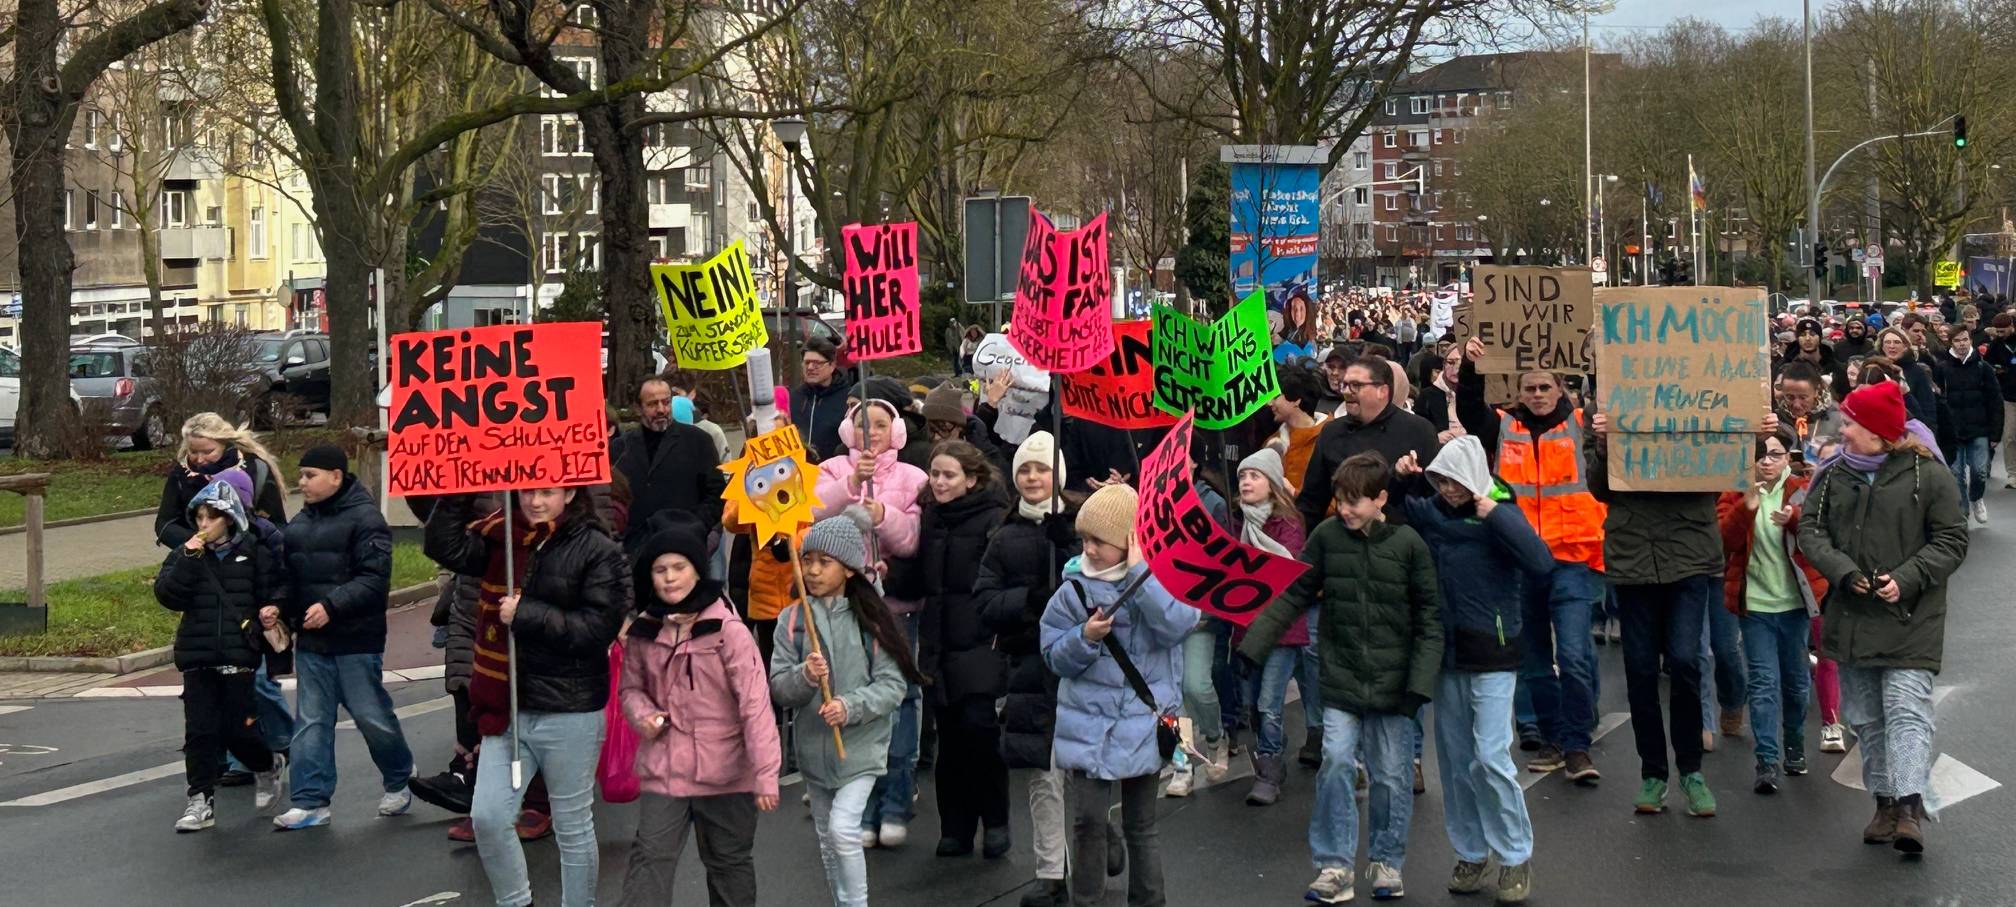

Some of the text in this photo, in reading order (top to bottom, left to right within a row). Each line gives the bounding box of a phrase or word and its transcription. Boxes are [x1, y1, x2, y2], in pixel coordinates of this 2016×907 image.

[1068, 223, 1101, 286] IST
[661, 247, 754, 320] NEIN!
[1484, 274, 1561, 304] SIND
[1158, 310, 1187, 348] ICH
[1479, 321, 1552, 349] EUCH
[1522, 304, 1574, 324] WIR
[1159, 331, 1257, 381] NICHT INS
[392, 376, 575, 434] ANGST
[436, 433, 471, 456] DEM
[389, 459, 446, 492] KLARE
[447, 455, 547, 488] TRENNUNG
[1180, 505, 1271, 576] BIN
[1172, 558, 1273, 614] 10
